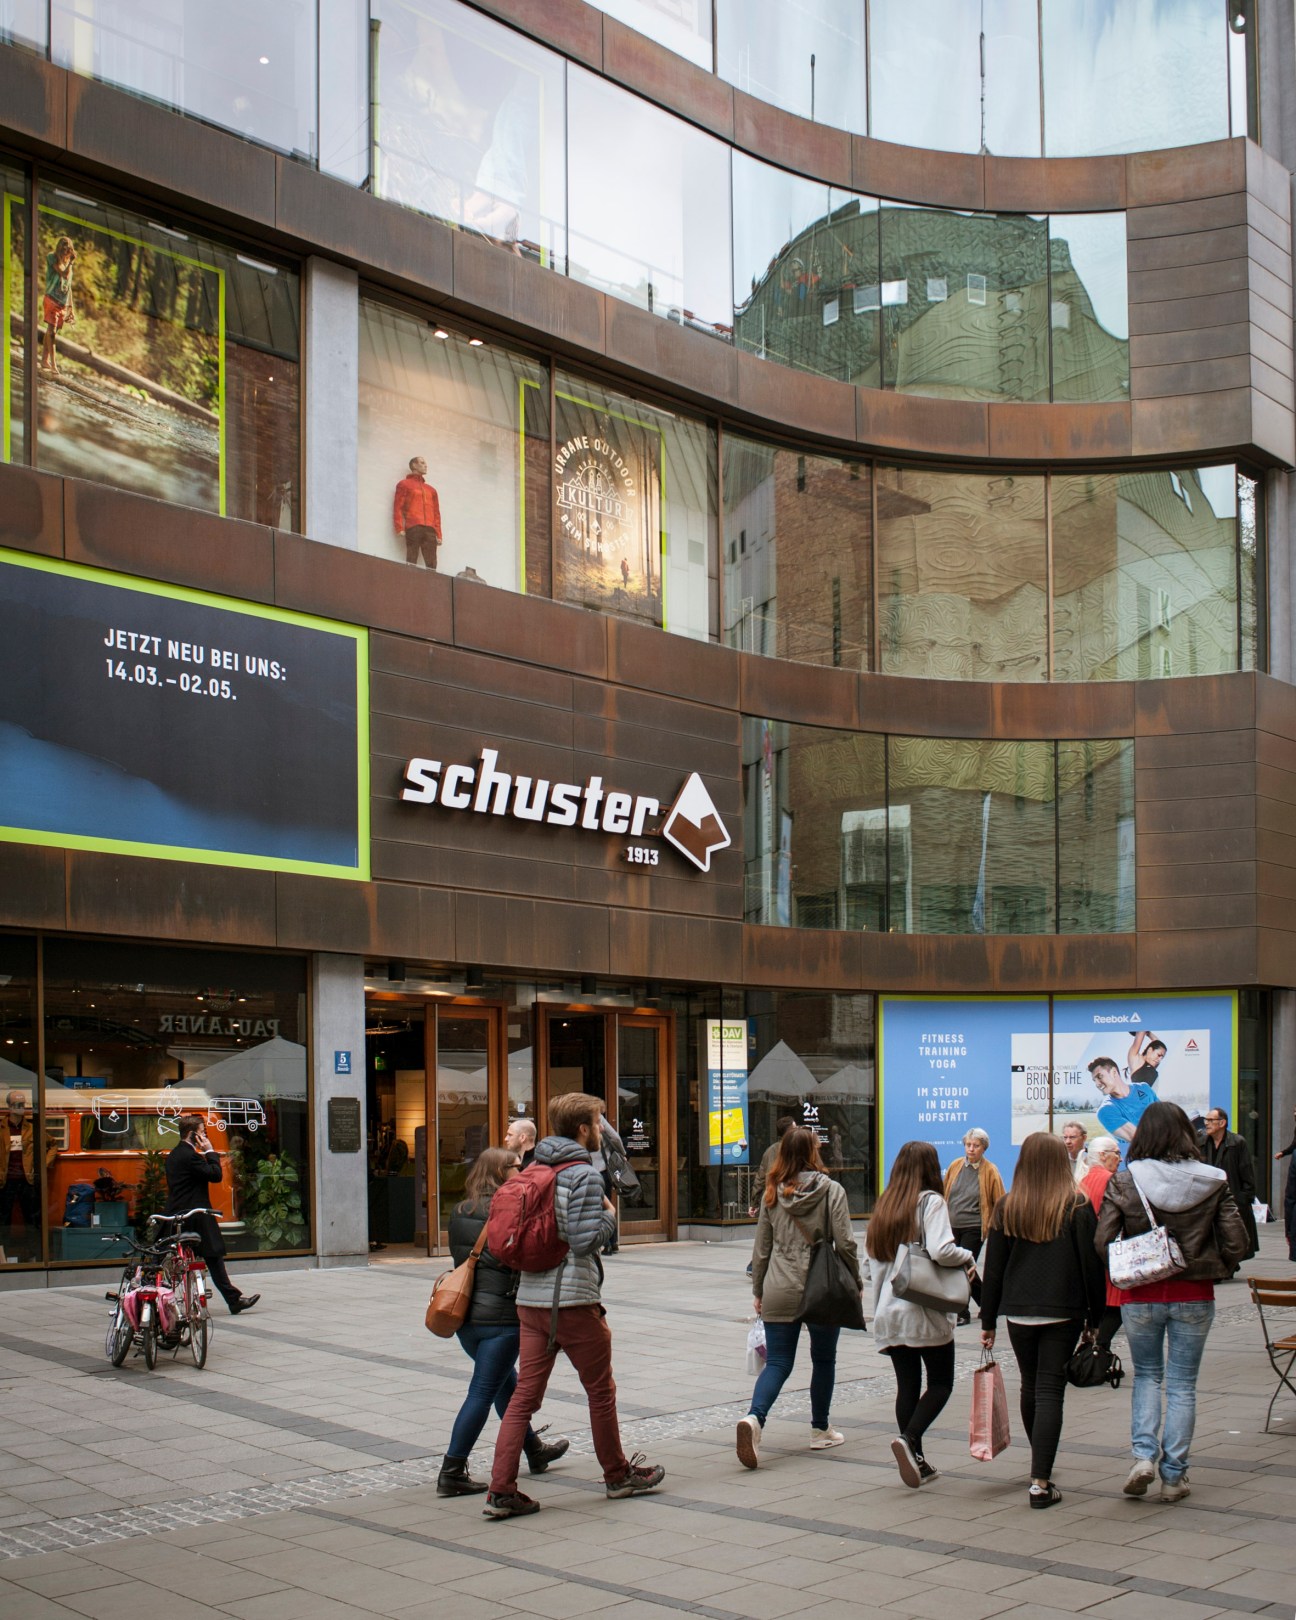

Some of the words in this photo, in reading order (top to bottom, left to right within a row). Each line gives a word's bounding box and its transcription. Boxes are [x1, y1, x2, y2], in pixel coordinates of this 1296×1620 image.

[555, 435, 590, 475] URBANE
[594, 438, 636, 498] OUTDOOR
[568, 488, 622, 517] KULTUR
[560, 513, 582, 541] BEIM
[585, 532, 631, 553] SCHUSTER
[104, 628, 162, 656] JETZT
[168, 639, 204, 664] NEU
[211, 648, 239, 672] BEI
[245, 655, 287, 681] UNS:
[402, 748, 659, 836] schuster
[627, 846, 659, 865] 1913
[1093, 1014, 1129, 1024] Reebok
[722, 1028, 742, 1038] DAV
[921, 1033, 964, 1043] FITNESS
[918, 1046, 967, 1056] TRAINING
[340, 1053, 347, 1064] 5
[929, 1059, 957, 1069] YOGA
[1026, 1072, 1061, 1085] BRING
[1064, 1071, 1082, 1085] THE
[917, 1087, 928, 1097] IM
[932, 1087, 969, 1097] STUDIO
[1026, 1086, 1056, 1101] COOL
[803, 1102, 819, 1116] 2x
[926, 1099, 936, 1109] IN
[940, 1099, 960, 1109] DER
[918, 1112, 968, 1122] HOFSTATT
[632, 1118, 644, 1129] 2x
